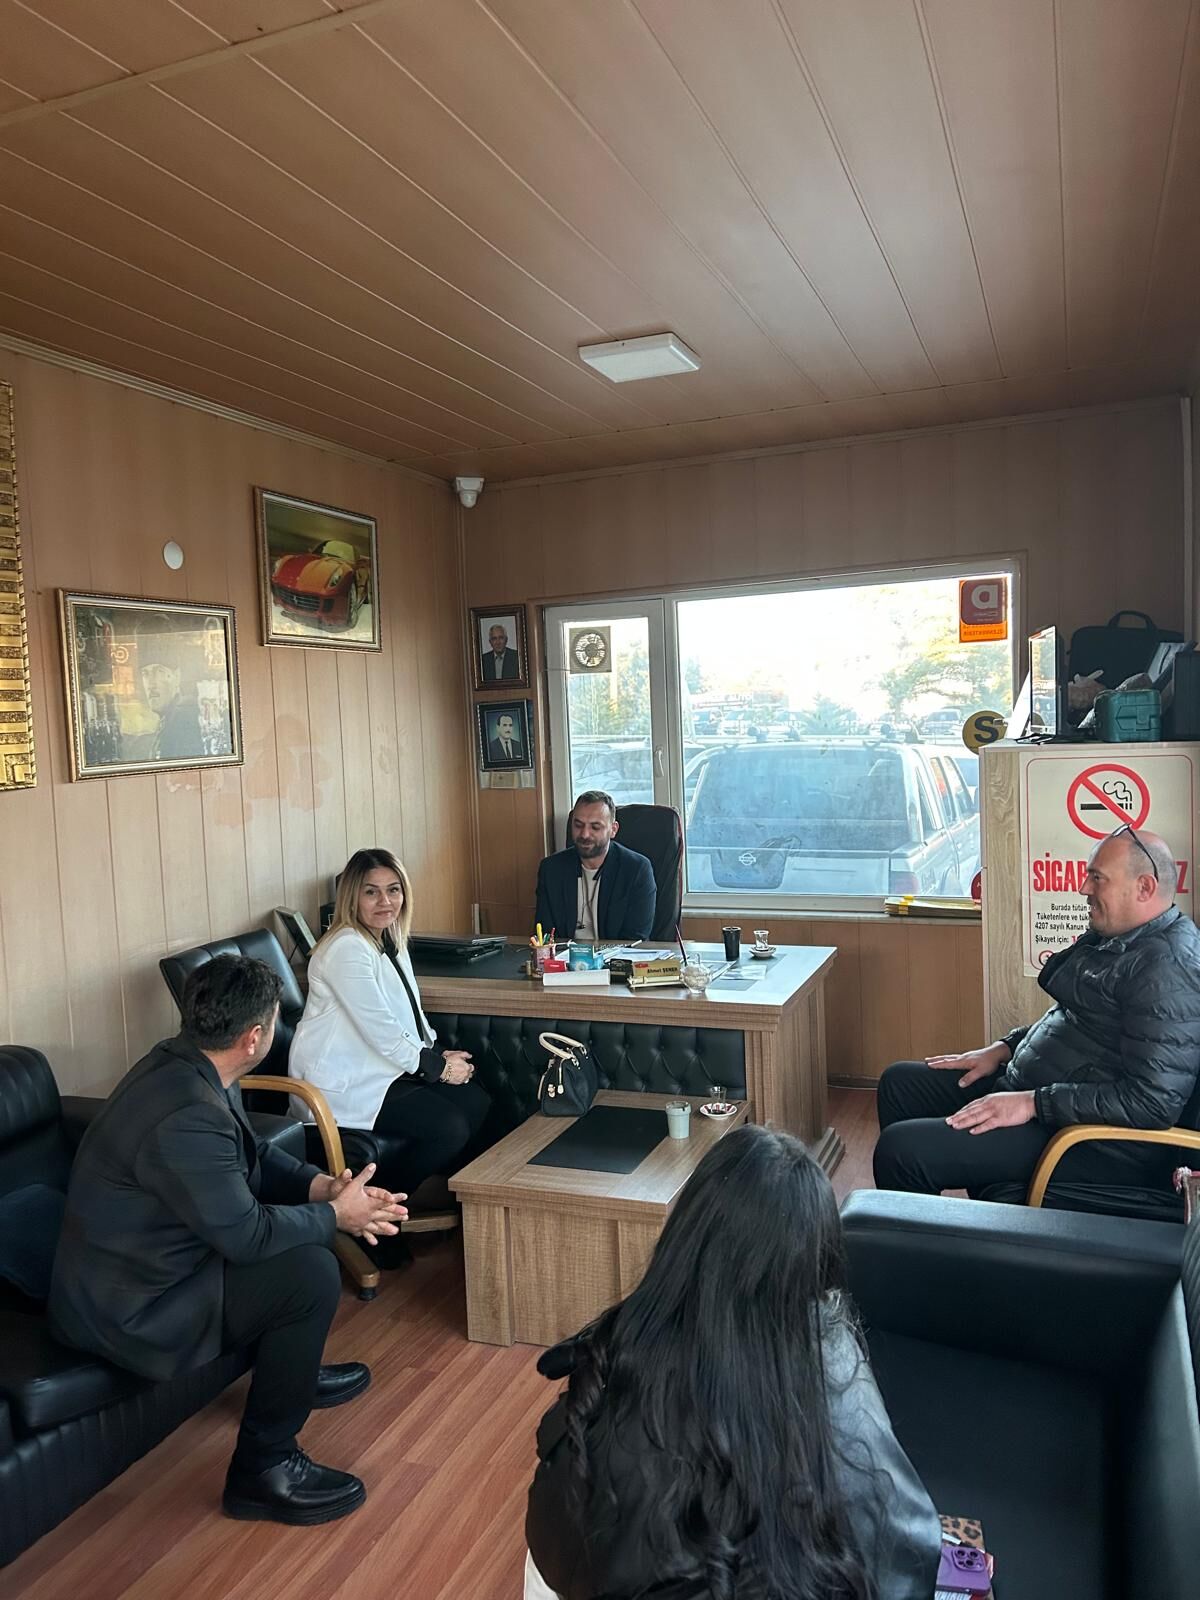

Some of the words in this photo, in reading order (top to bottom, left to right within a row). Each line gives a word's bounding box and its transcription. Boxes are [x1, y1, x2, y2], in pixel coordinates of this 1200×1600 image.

[974, 715, 999, 744] S
[1033, 852, 1088, 893] SİGAR
[1051, 903, 1071, 911] Burada
[1072, 903, 1088, 911] tütün
[1036, 912, 1070, 921] Tüketenlere
[1035, 922, 1049, 930] 4207
[1050, 923, 1065, 932] sayılı
[1035, 935, 1056, 944] Şikayet
